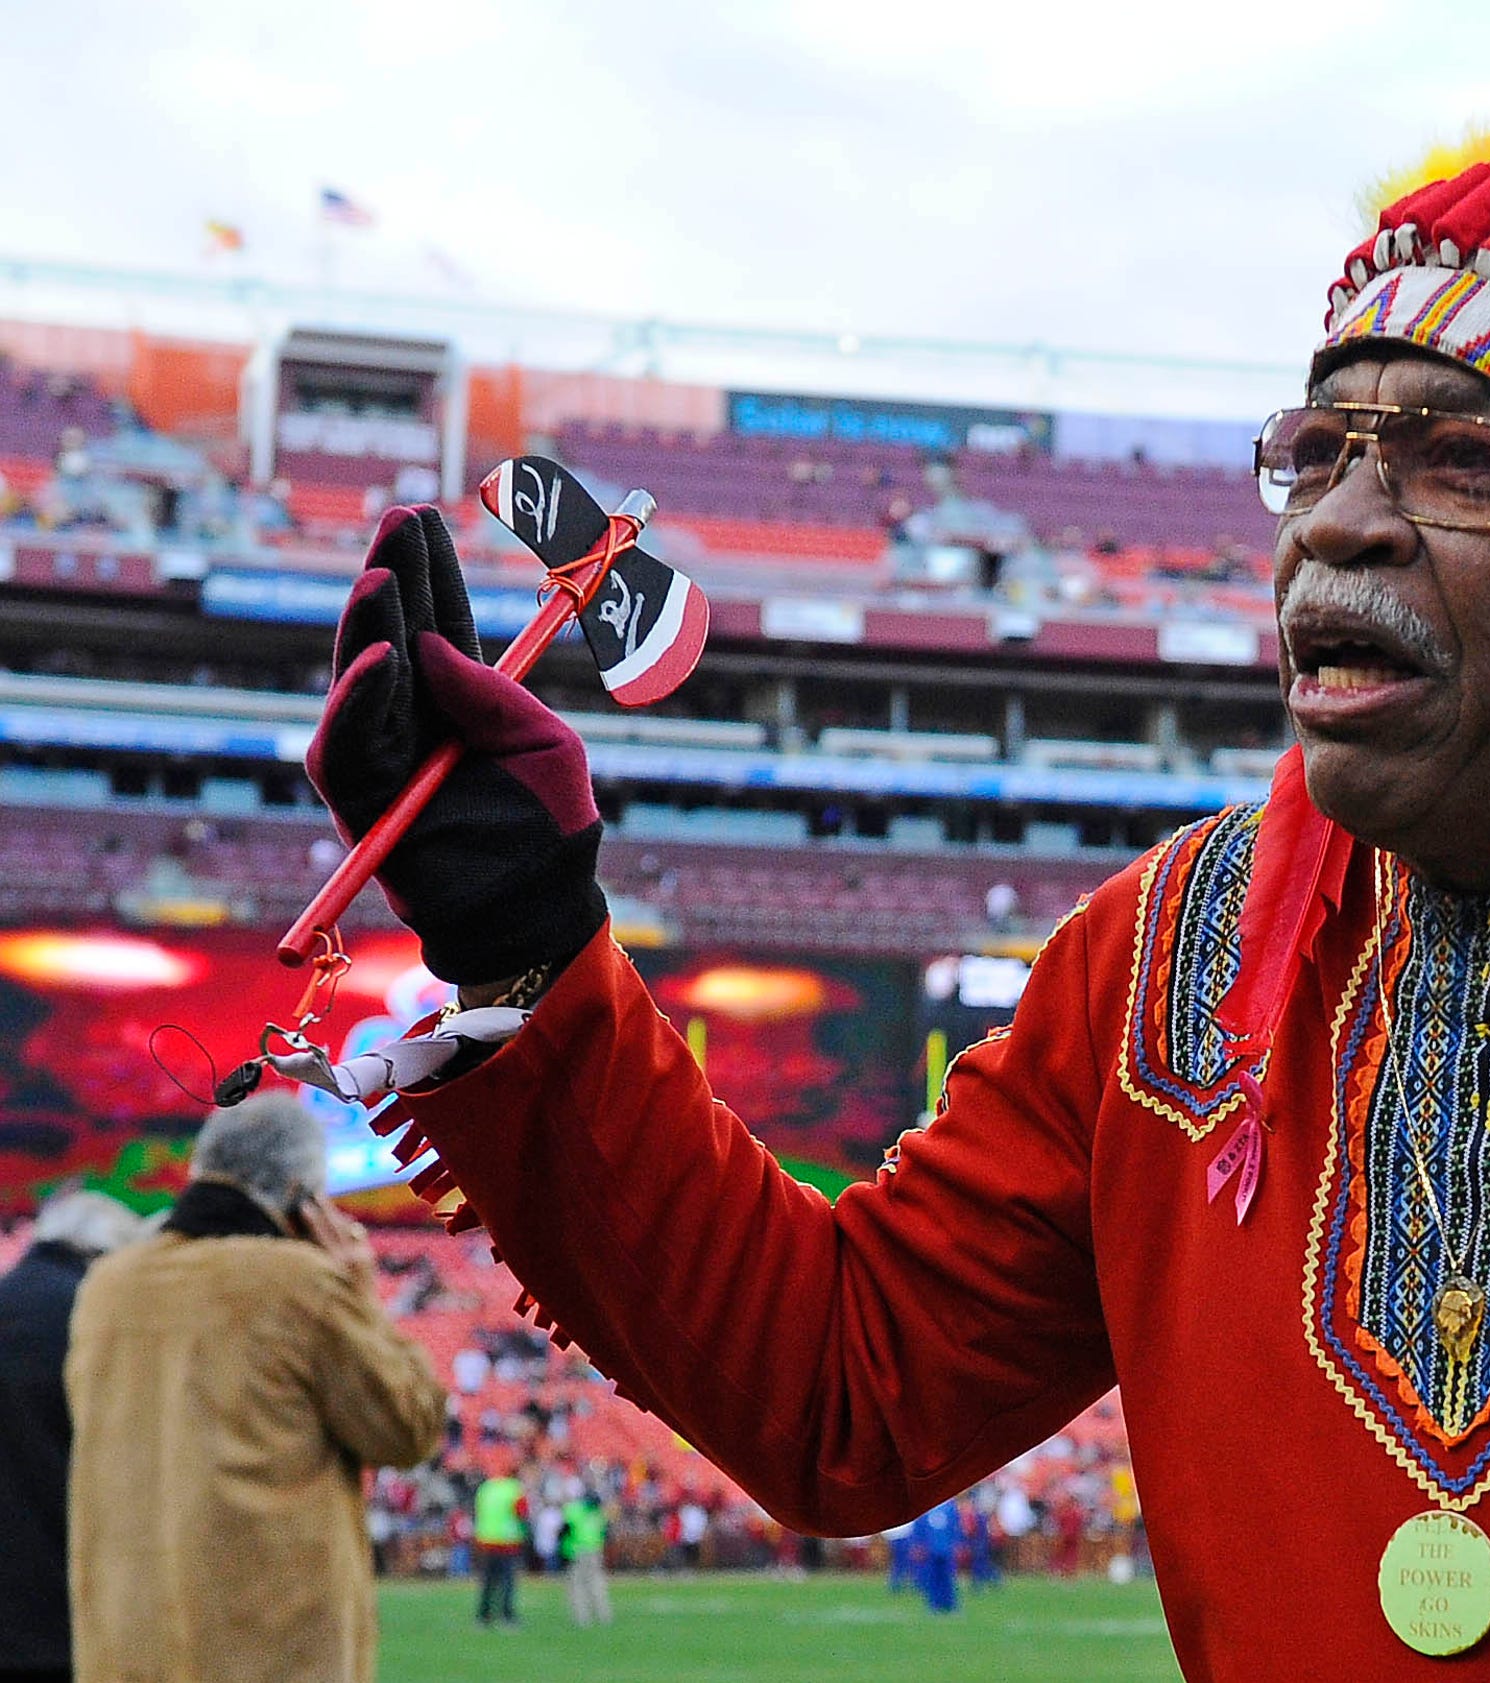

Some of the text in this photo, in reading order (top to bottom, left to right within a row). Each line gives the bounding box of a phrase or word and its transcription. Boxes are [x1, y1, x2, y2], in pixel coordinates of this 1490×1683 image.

[1418, 1543, 1454, 1559] THE
[1400, 1568, 1472, 1588] POWER
[1421, 1597, 1448, 1613] GO
[1409, 1620, 1462, 1640] SKINS
